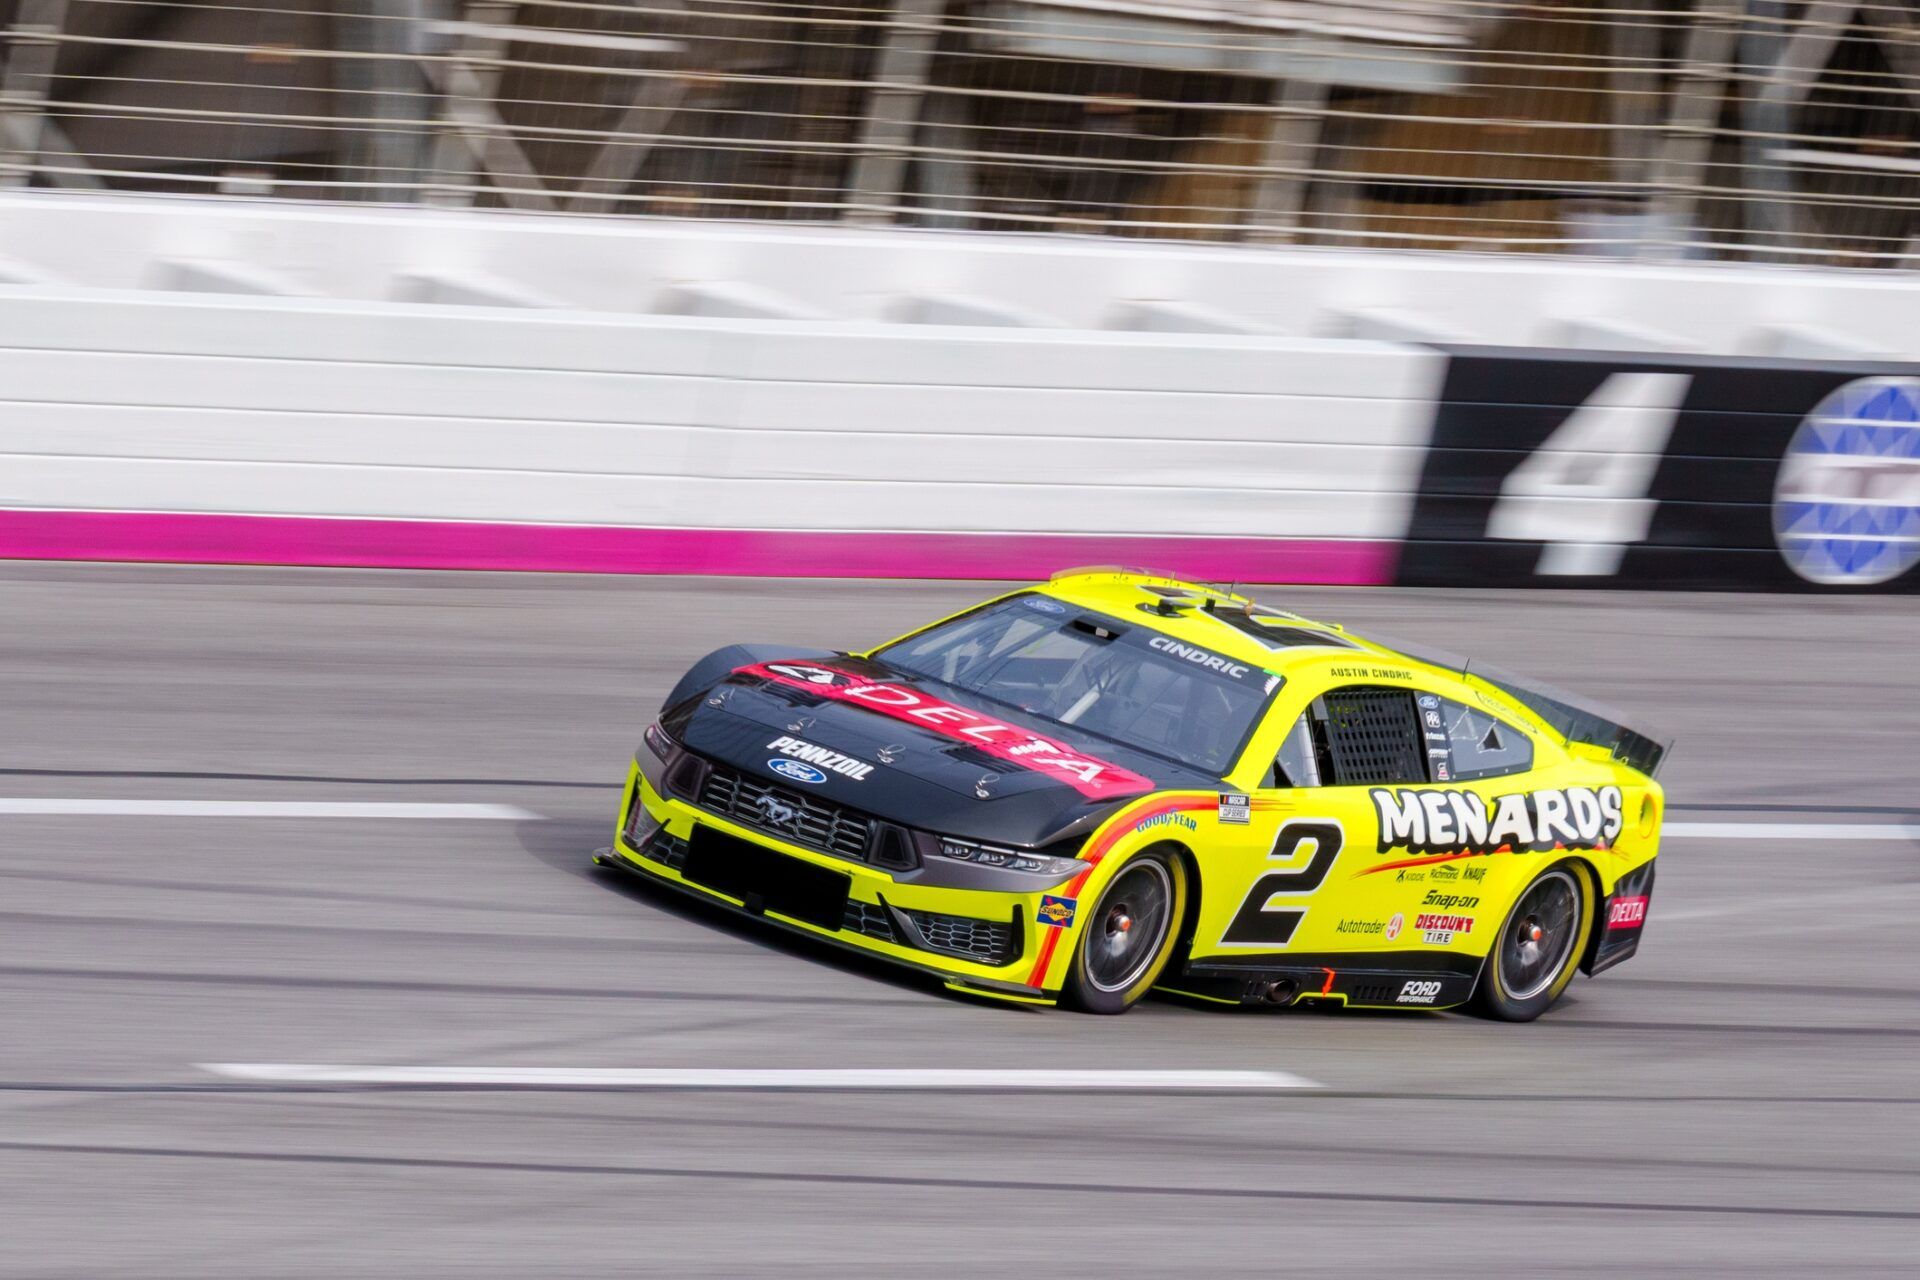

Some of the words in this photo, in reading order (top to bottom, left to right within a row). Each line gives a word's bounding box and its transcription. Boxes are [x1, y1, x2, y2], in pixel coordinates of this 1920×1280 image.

[1484, 373, 1694, 576] 4
[1149, 636, 1250, 679] CINDRIC
[1330, 668, 1369, 678] AUSTIN
[1372, 668, 1412, 680] CINDRIC
[766, 736, 875, 781] PENNZOIL
[773, 760, 820, 780] Ford
[1376, 787, 1622, 849] MENARDS
[1220, 820, 1343, 945] 2
[1462, 864, 1487, 884] KNAUF
[1422, 889, 1480, 909] Snap-on
[1040, 905, 1074, 918] SUNOCO
[1609, 902, 1644, 923] DELTA
[1336, 919, 1385, 934] Autotrader
[1414, 914, 1475, 933] DISCOUNT
[1426, 932, 1451, 943] TIRE
[1400, 981, 1442, 996] FORD
[1395, 995, 1436, 1003] PERFORMANCE
